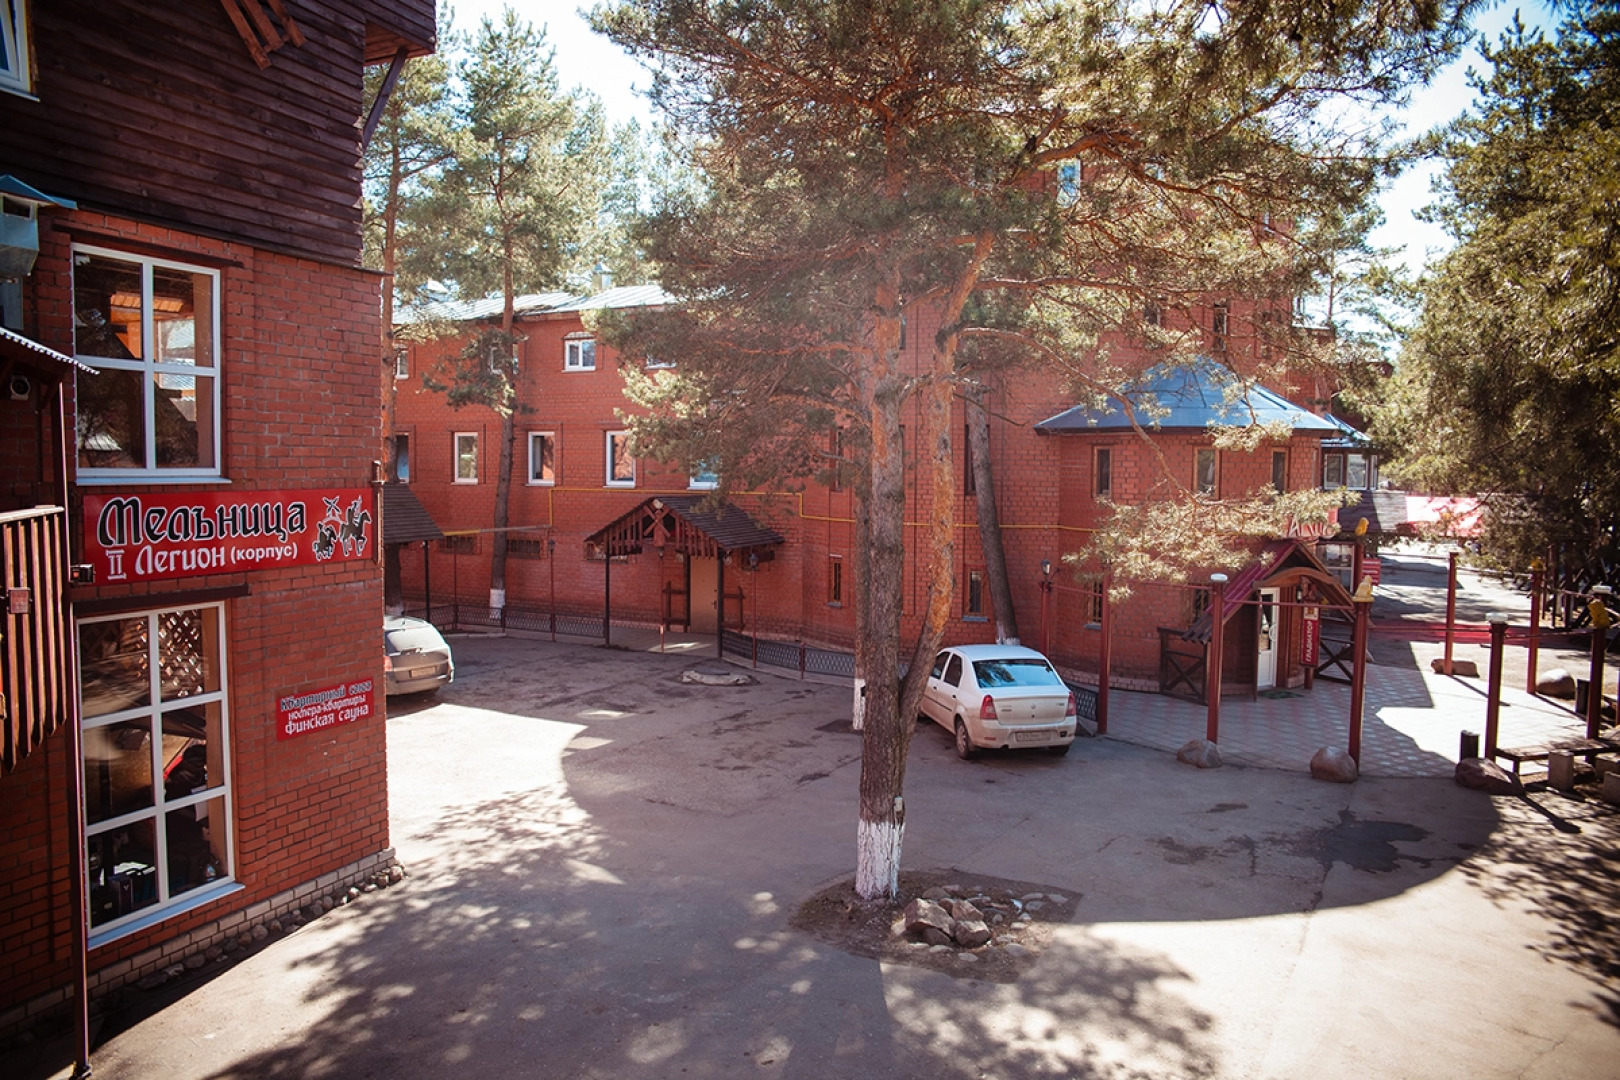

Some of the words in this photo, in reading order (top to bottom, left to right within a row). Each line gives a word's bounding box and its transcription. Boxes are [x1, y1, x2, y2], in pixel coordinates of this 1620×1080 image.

[97, 496, 306, 547] Мельница
[135, 545, 226, 575] Легион
[230, 542, 298, 564] (корпус)
[338, 704, 369, 722] сауна
